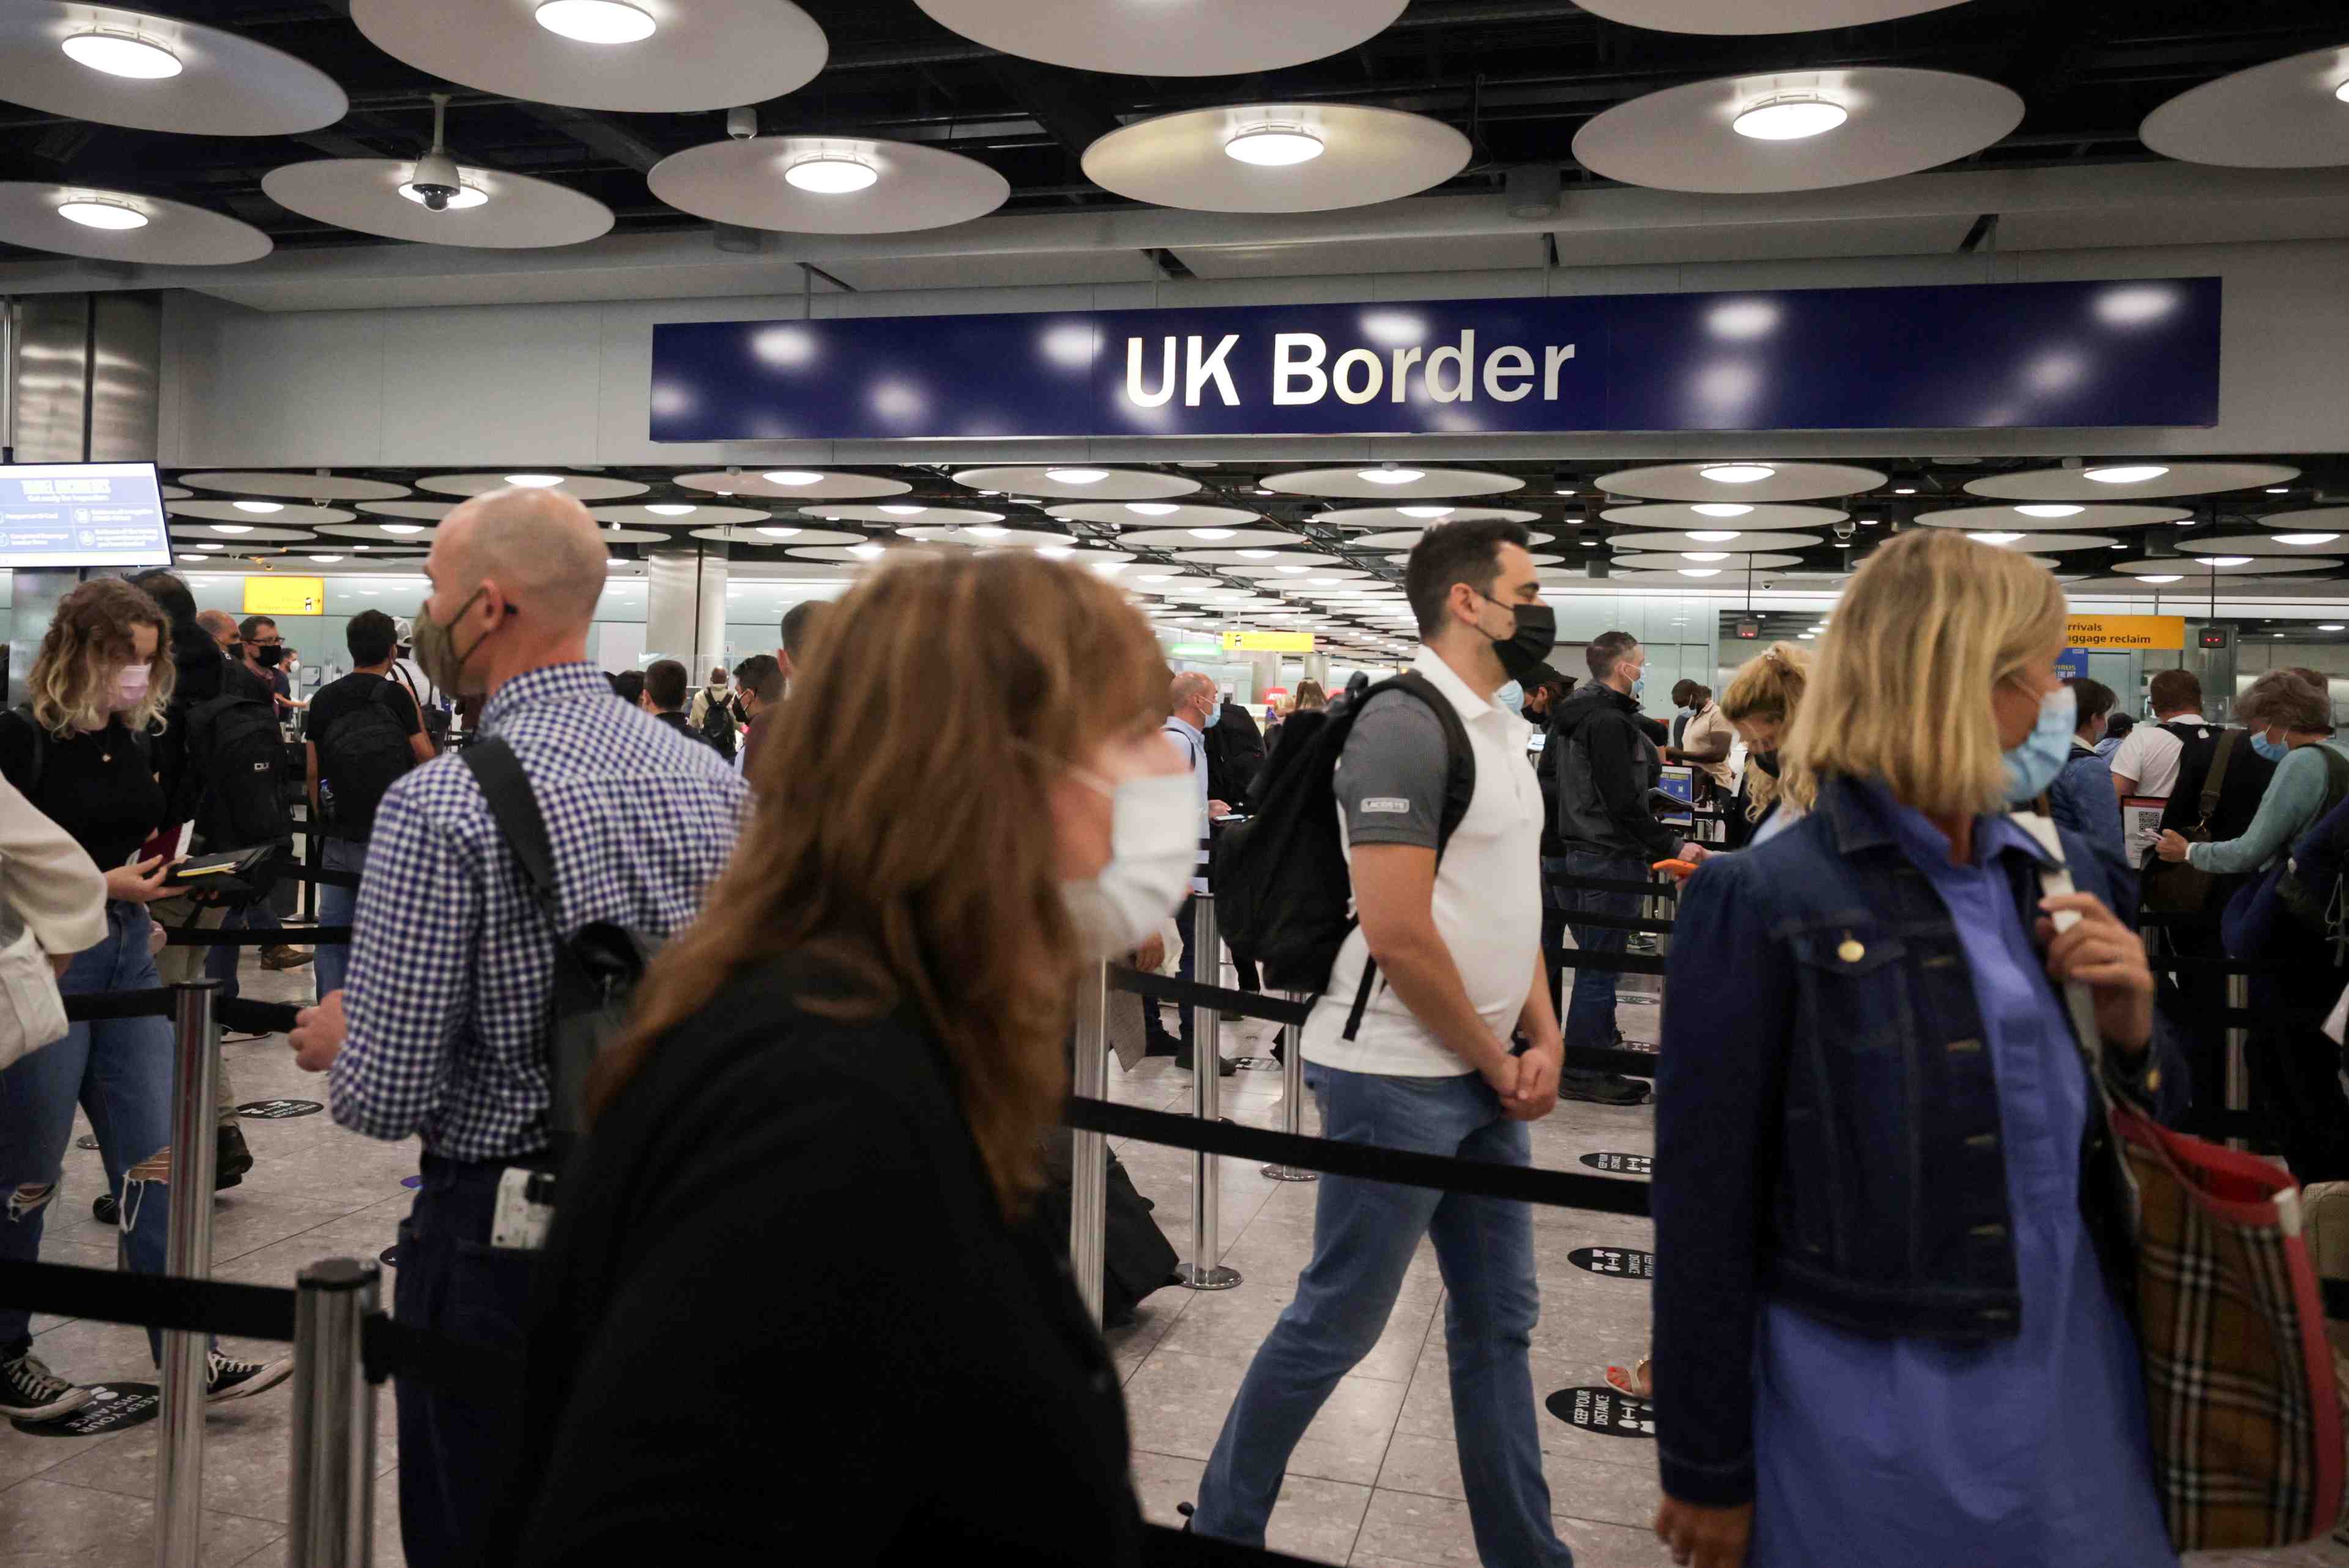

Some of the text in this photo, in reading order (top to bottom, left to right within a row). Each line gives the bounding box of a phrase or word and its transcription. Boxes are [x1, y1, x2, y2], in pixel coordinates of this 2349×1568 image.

[1126, 329, 1575, 407] UK Border
[2066, 623, 2103, 631] rrivals
[2110, 635, 2151, 644] reclaim
[65, 1394, 142, 1428] DISTANCE
[76, 1413, 127, 1433] YOUR
[1574, 1390, 1590, 1424] KEEP YOUR
[1594, 1394, 1609, 1426] DISTANCE
